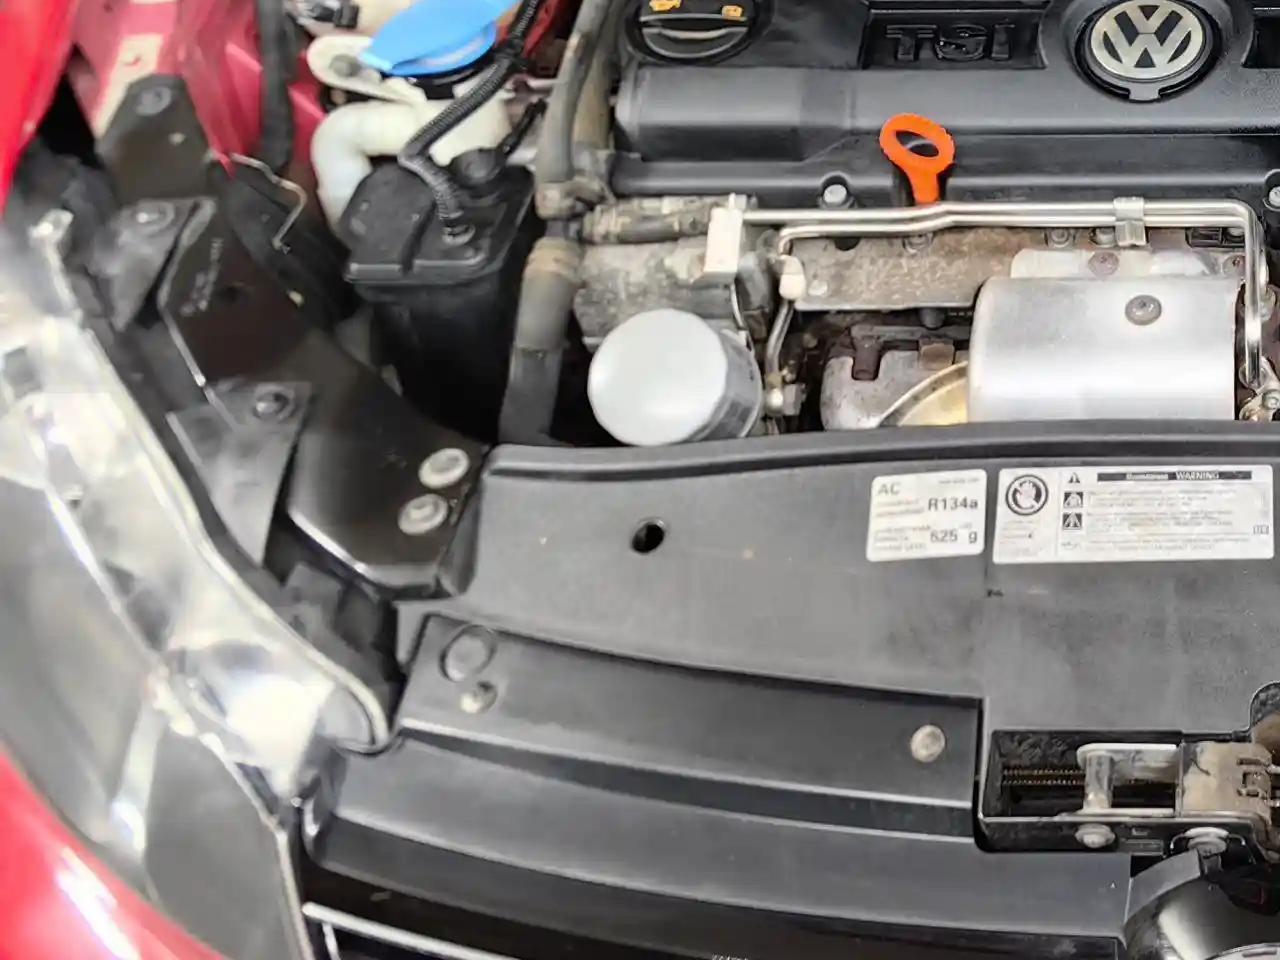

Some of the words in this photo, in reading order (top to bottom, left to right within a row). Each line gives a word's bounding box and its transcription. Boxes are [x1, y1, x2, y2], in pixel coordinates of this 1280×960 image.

[1175, 471, 1220, 480] WARNING
[877, 481, 901, 496] AC
[927, 496, 979, 512] R134a
[968, 531, 978, 545] g
